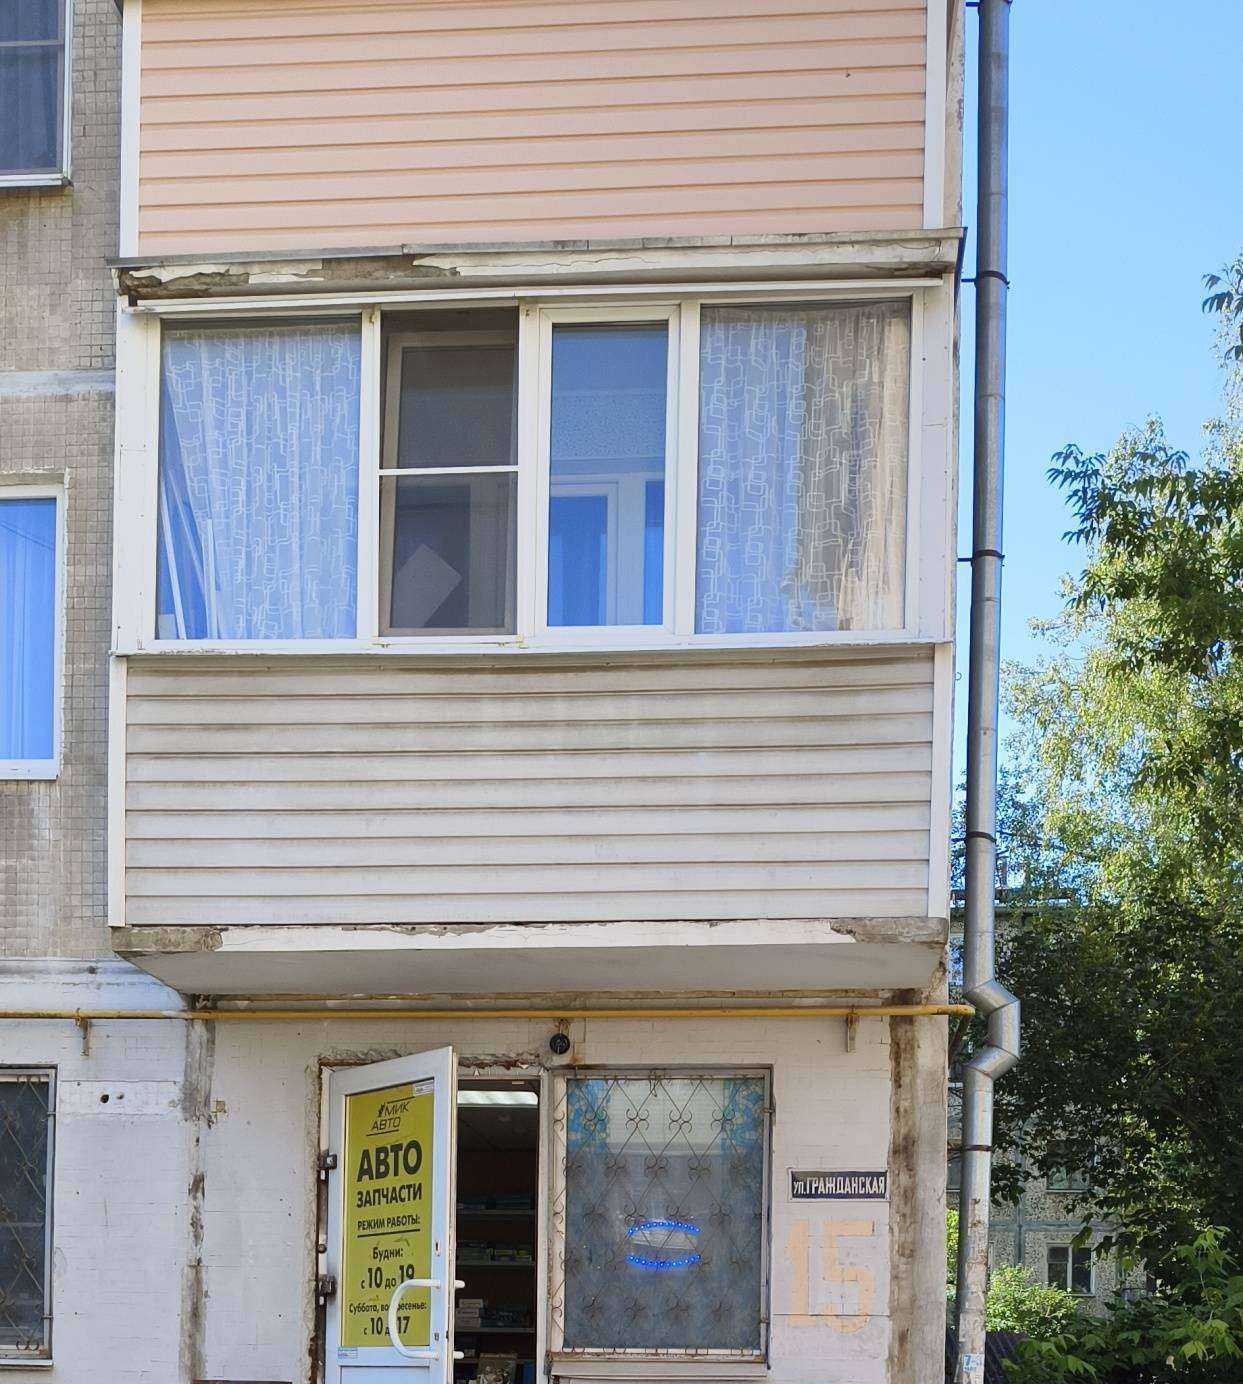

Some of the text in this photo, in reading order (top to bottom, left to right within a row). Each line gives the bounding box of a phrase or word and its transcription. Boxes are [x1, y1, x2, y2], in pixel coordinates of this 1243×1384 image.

[372, 1117, 401, 1130] АВТО
[357, 1139, 423, 1182] АВТО
[357, 1183, 422, 1208] ЗАПЧАСТИ
[357, 1214, 420, 1231] РЕЖИМ РАБОТЫ:
[373, 1247, 404, 1262] Будни:
[361, 1264, 415, 1290] с 10 до 19
[785, 1219, 875, 1334] 15
[370, 1317, 383, 1334] 10
[397, 1316, 410, 1334] 17
